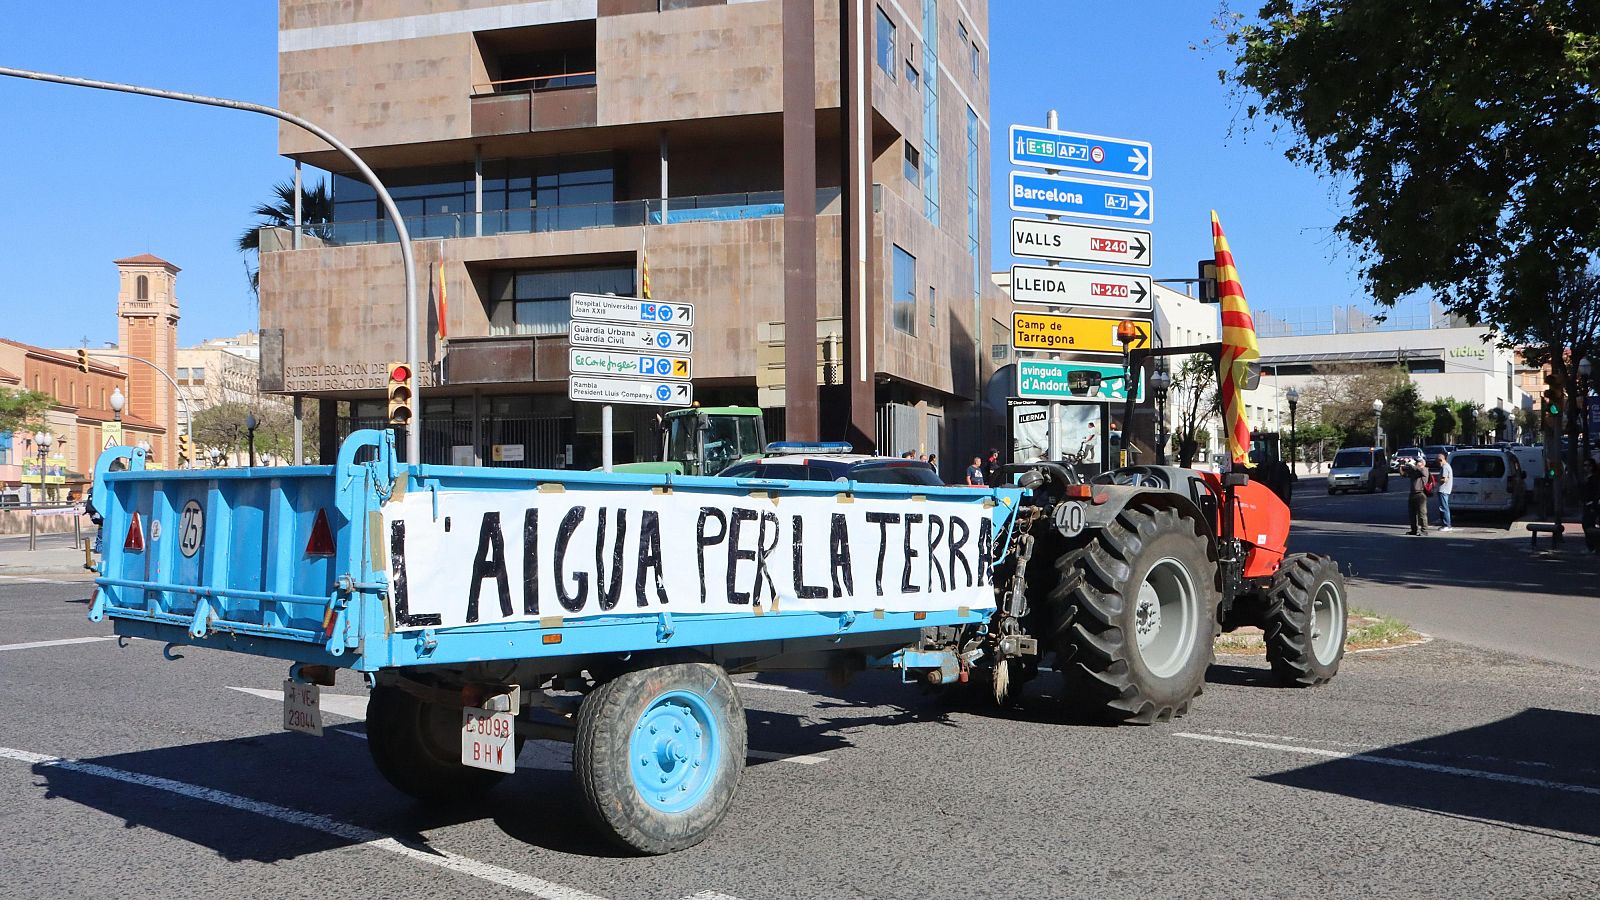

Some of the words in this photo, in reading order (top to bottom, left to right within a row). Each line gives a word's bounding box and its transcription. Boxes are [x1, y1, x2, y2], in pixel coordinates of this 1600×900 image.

[1029, 141, 1053, 154] E-15
[1059, 145, 1087, 158] AP-7
[1014, 185, 1083, 205] Barcelona
[1107, 195, 1127, 208] A-7
[1016, 231, 1062, 247] VALLS
[1091, 239, 1127, 252] N-240
[1016, 278, 1066, 293] LLEIDA
[1092, 284, 1127, 297] N-240
[575, 300, 601, 308] Hospital
[603, 302, 638, 310] Universitari
[574, 325, 605, 335] Guàrdia
[607, 328, 636, 337] Urbana
[1017, 319, 1046, 331] Camp
[1050, 321, 1062, 331] de
[573, 333, 605, 343] Guàrdia
[607, 336, 625, 345] Civil
[1017, 332, 1075, 346] Tarragona
[1449, 346, 1486, 360] viding
[286, 361, 368, 377] SUBDELEGACIÓN
[575, 355, 584, 366] El
[585, 356, 606, 367] Corte
[606, 355, 637, 372] Inglés
[1022, 366, 1063, 378] avinguda
[369, 377, 387, 388] DEL
[1022, 377, 1071, 391] d'Andorr
[573, 388, 603, 396] President
[621, 391, 653, 400] Companys
[1020, 413, 1046, 422] ILERNA
[1058, 505, 1082, 532] 40
[182, 507, 200, 549] 25
[391, 505, 669, 628] L'AIGUA
[697, 506, 780, 607] PER
[792, 512, 854, 599] LA
[866, 511, 994, 596] TERRA
[288, 710, 316, 729] 23044
